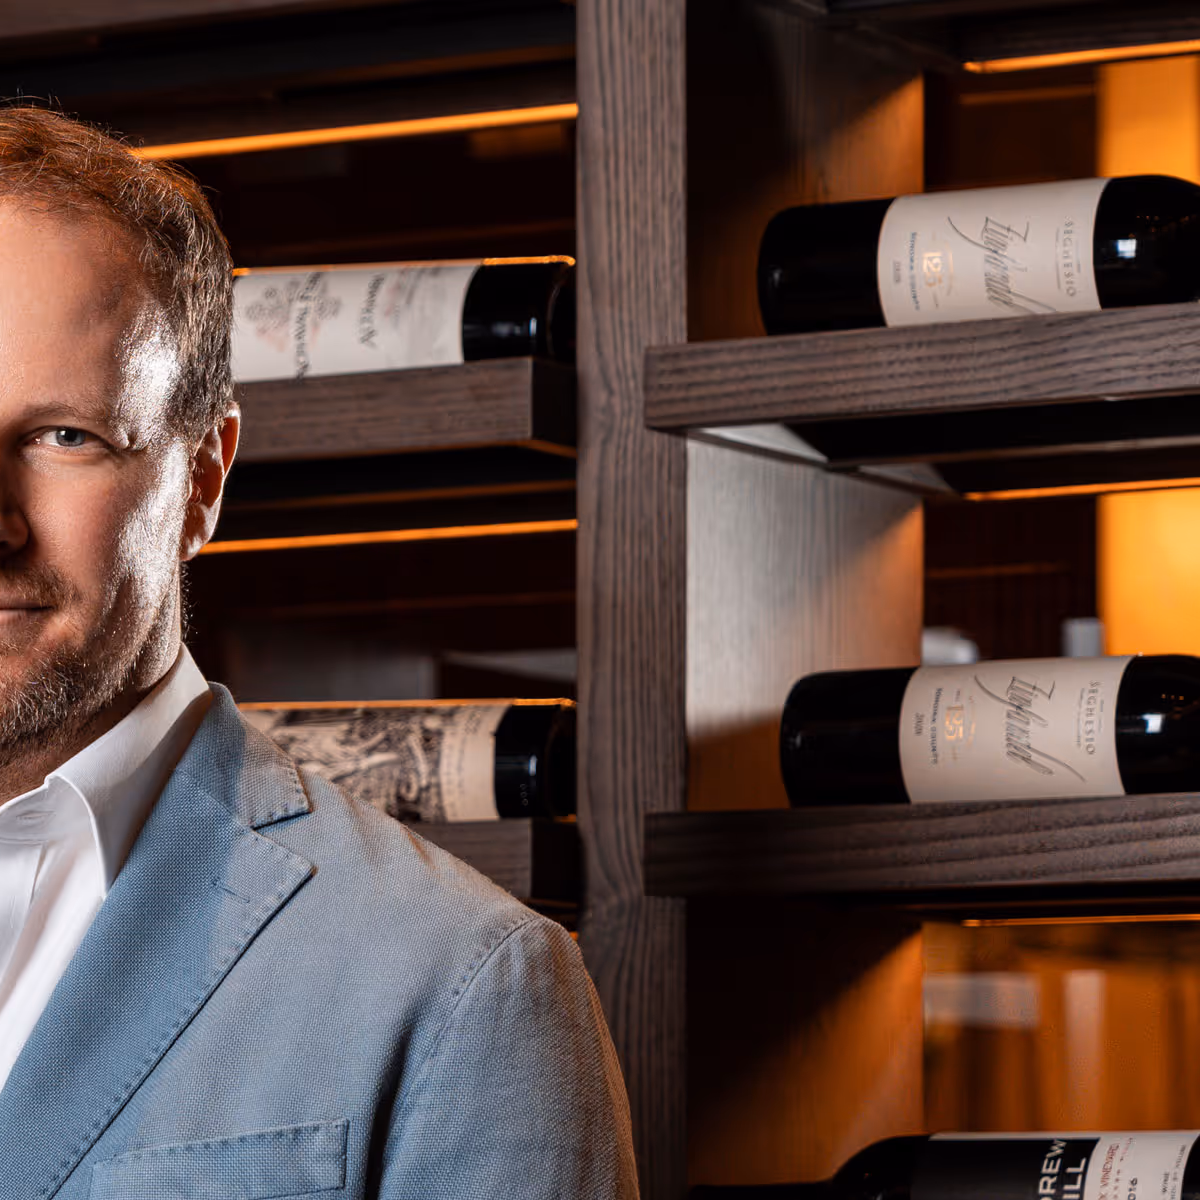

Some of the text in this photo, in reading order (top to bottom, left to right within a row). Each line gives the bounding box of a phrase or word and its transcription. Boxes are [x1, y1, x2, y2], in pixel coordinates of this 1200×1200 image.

[922, 252, 945, 288] 125
[1062, 217, 1077, 297] SEGHESIO
[945, 704, 964, 740] 125
[974, 674, 1087, 783] Zinfandel
[1084, 680, 1101, 756] SEGHESIO
[1100, 1143, 1120, 1188] VINEYARD
